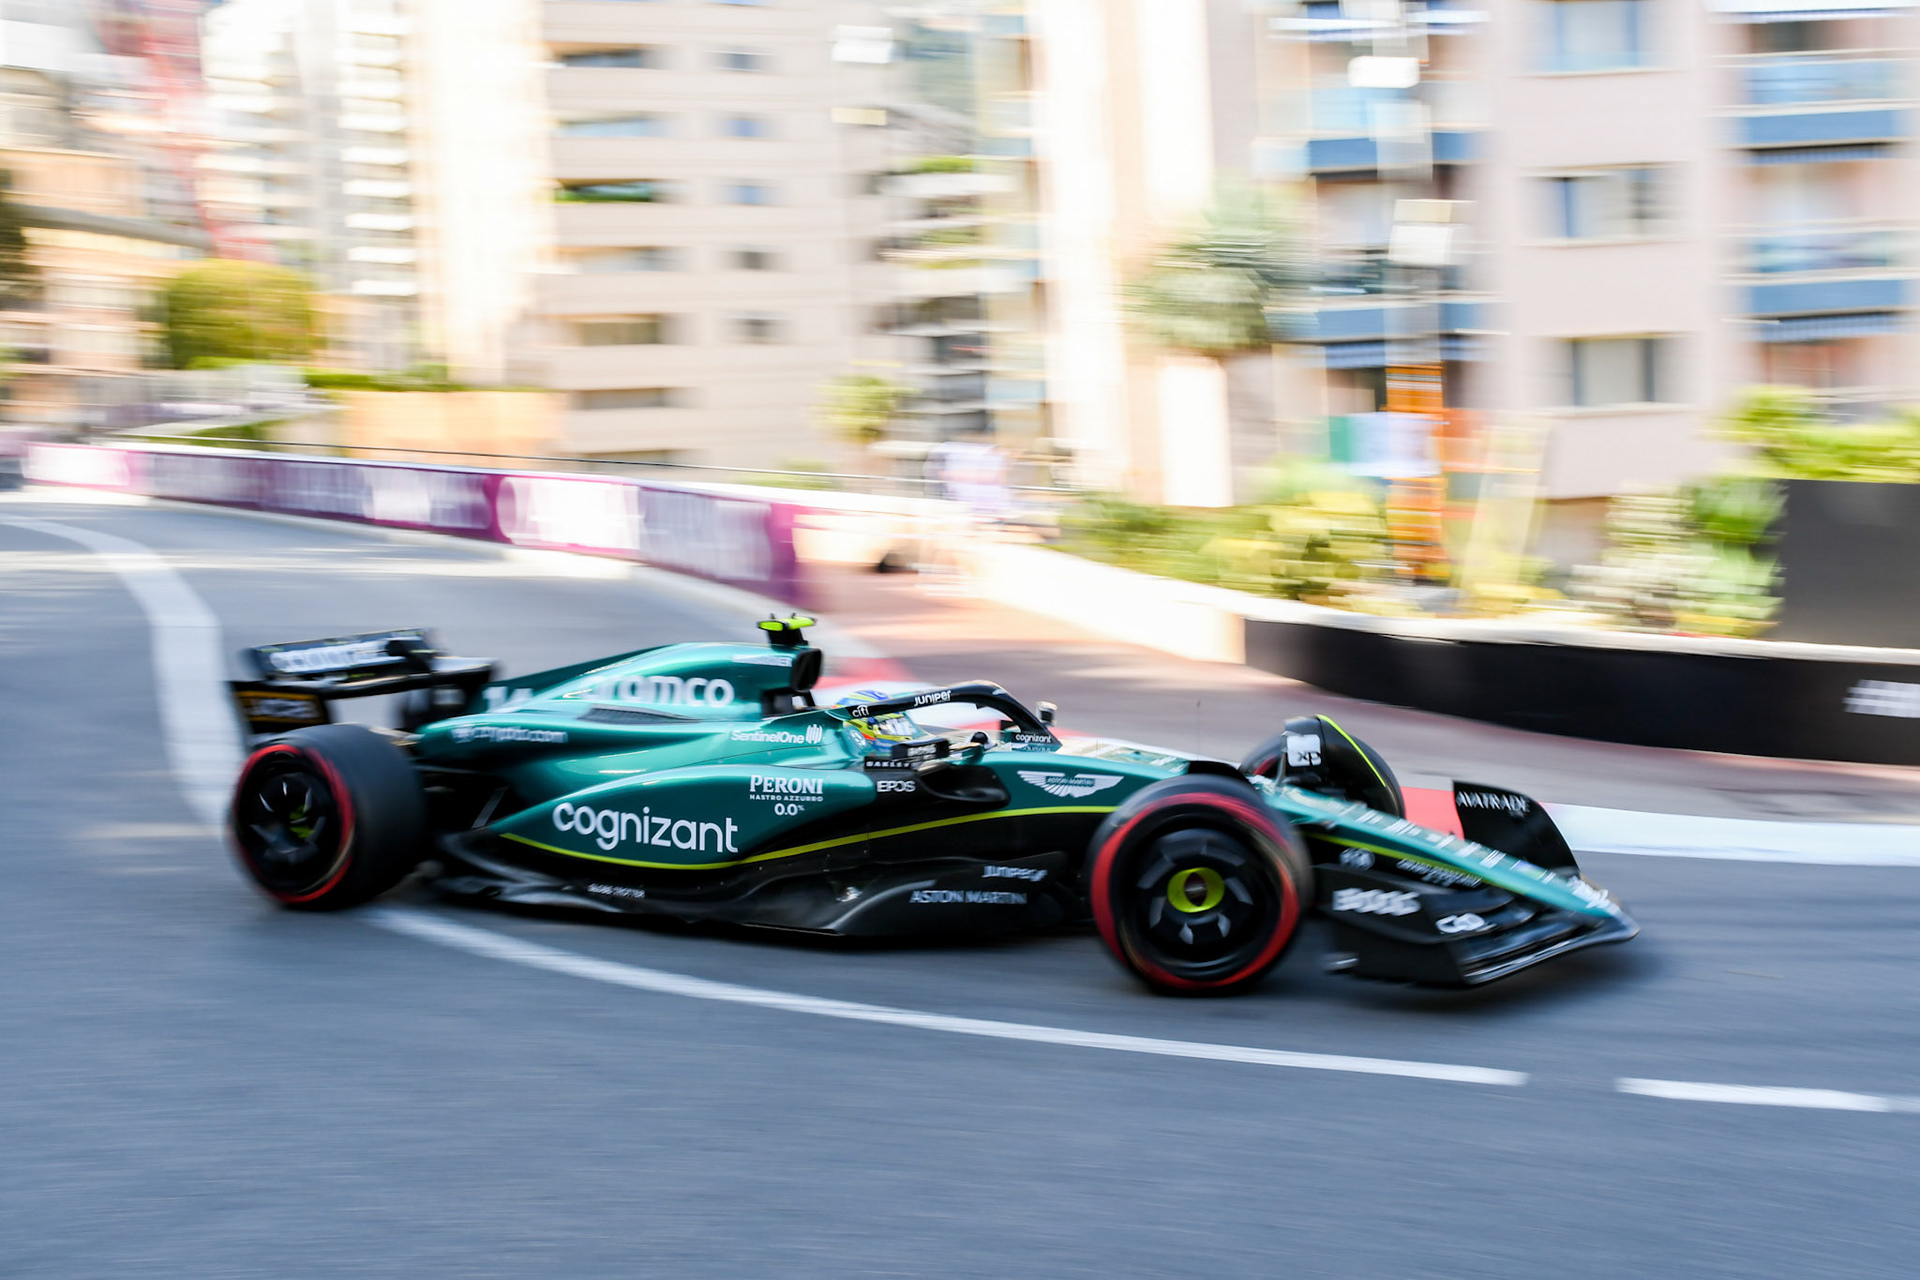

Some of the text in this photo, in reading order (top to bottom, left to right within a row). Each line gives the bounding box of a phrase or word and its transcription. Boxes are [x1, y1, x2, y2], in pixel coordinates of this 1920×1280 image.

[852, 704, 870, 718] citi
[731, 730, 805, 744] SentinelOne
[1015, 733, 1052, 744] cognizant
[750, 774, 824, 794] PERONI
[877, 780, 916, 793] EPOS
[552, 802, 739, 853] cognizant
[909, 890, 1028, 904] ASTON MARTIN
